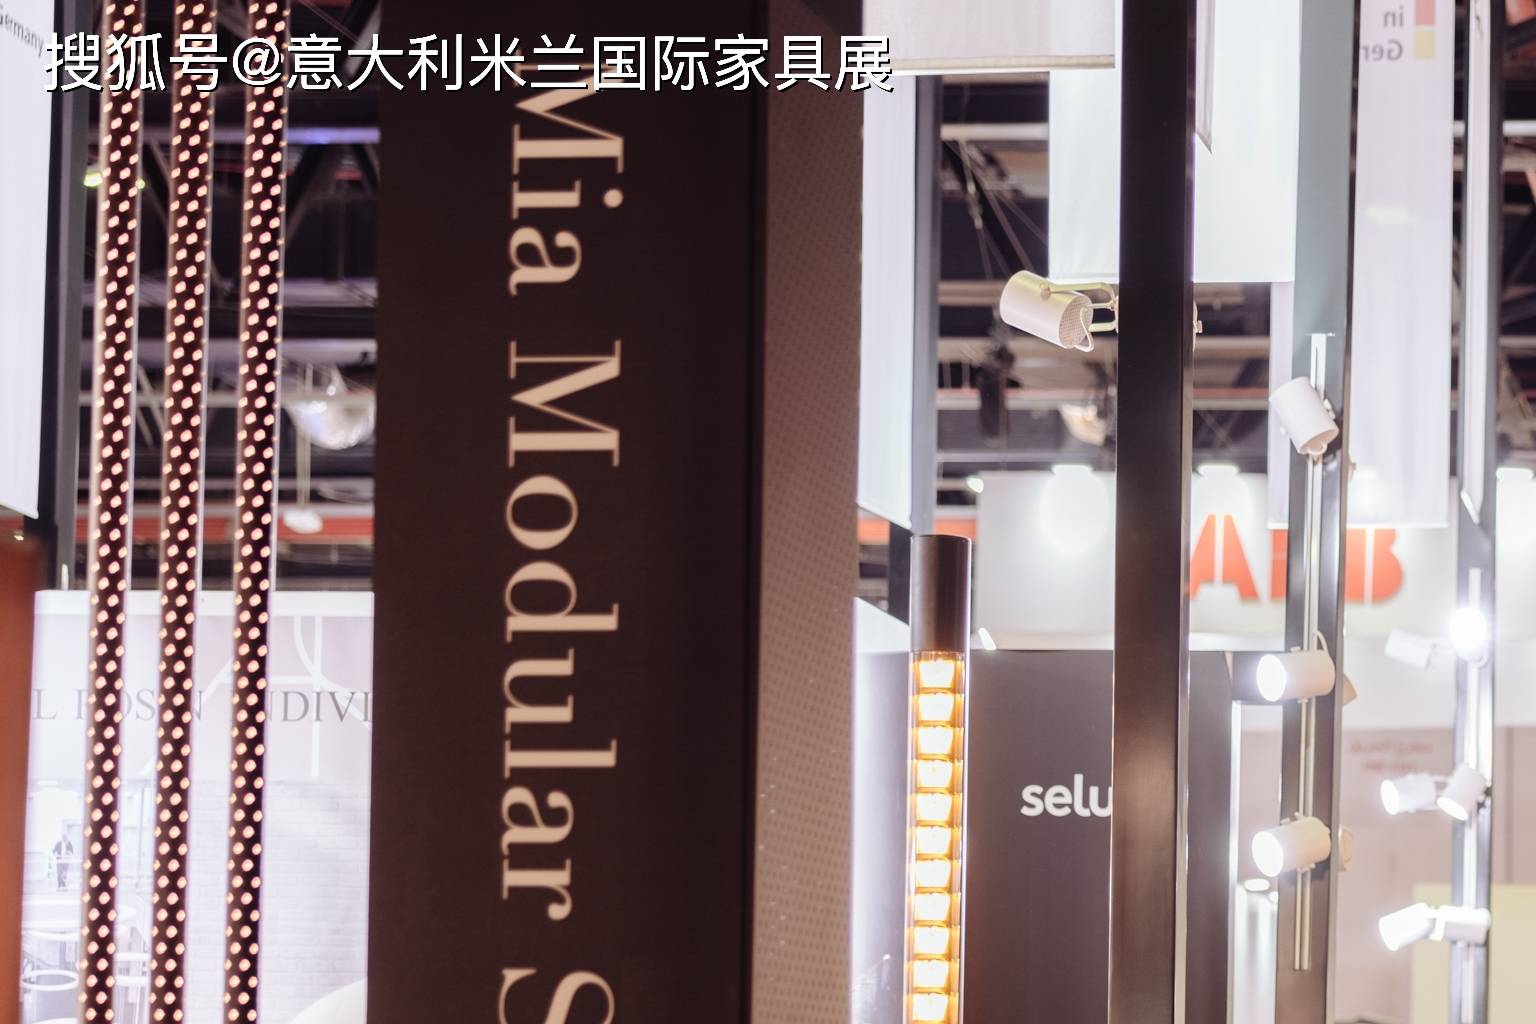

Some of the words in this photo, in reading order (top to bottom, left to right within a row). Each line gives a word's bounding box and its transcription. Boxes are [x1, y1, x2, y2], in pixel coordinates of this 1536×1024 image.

[0, 14, 44, 58] ermany
[508, 48, 624, 296] Mia
[1189, 514, 1404, 604] AB
[500, 340, 622, 922] Modular
[1020, 773, 1112, 818] selu
